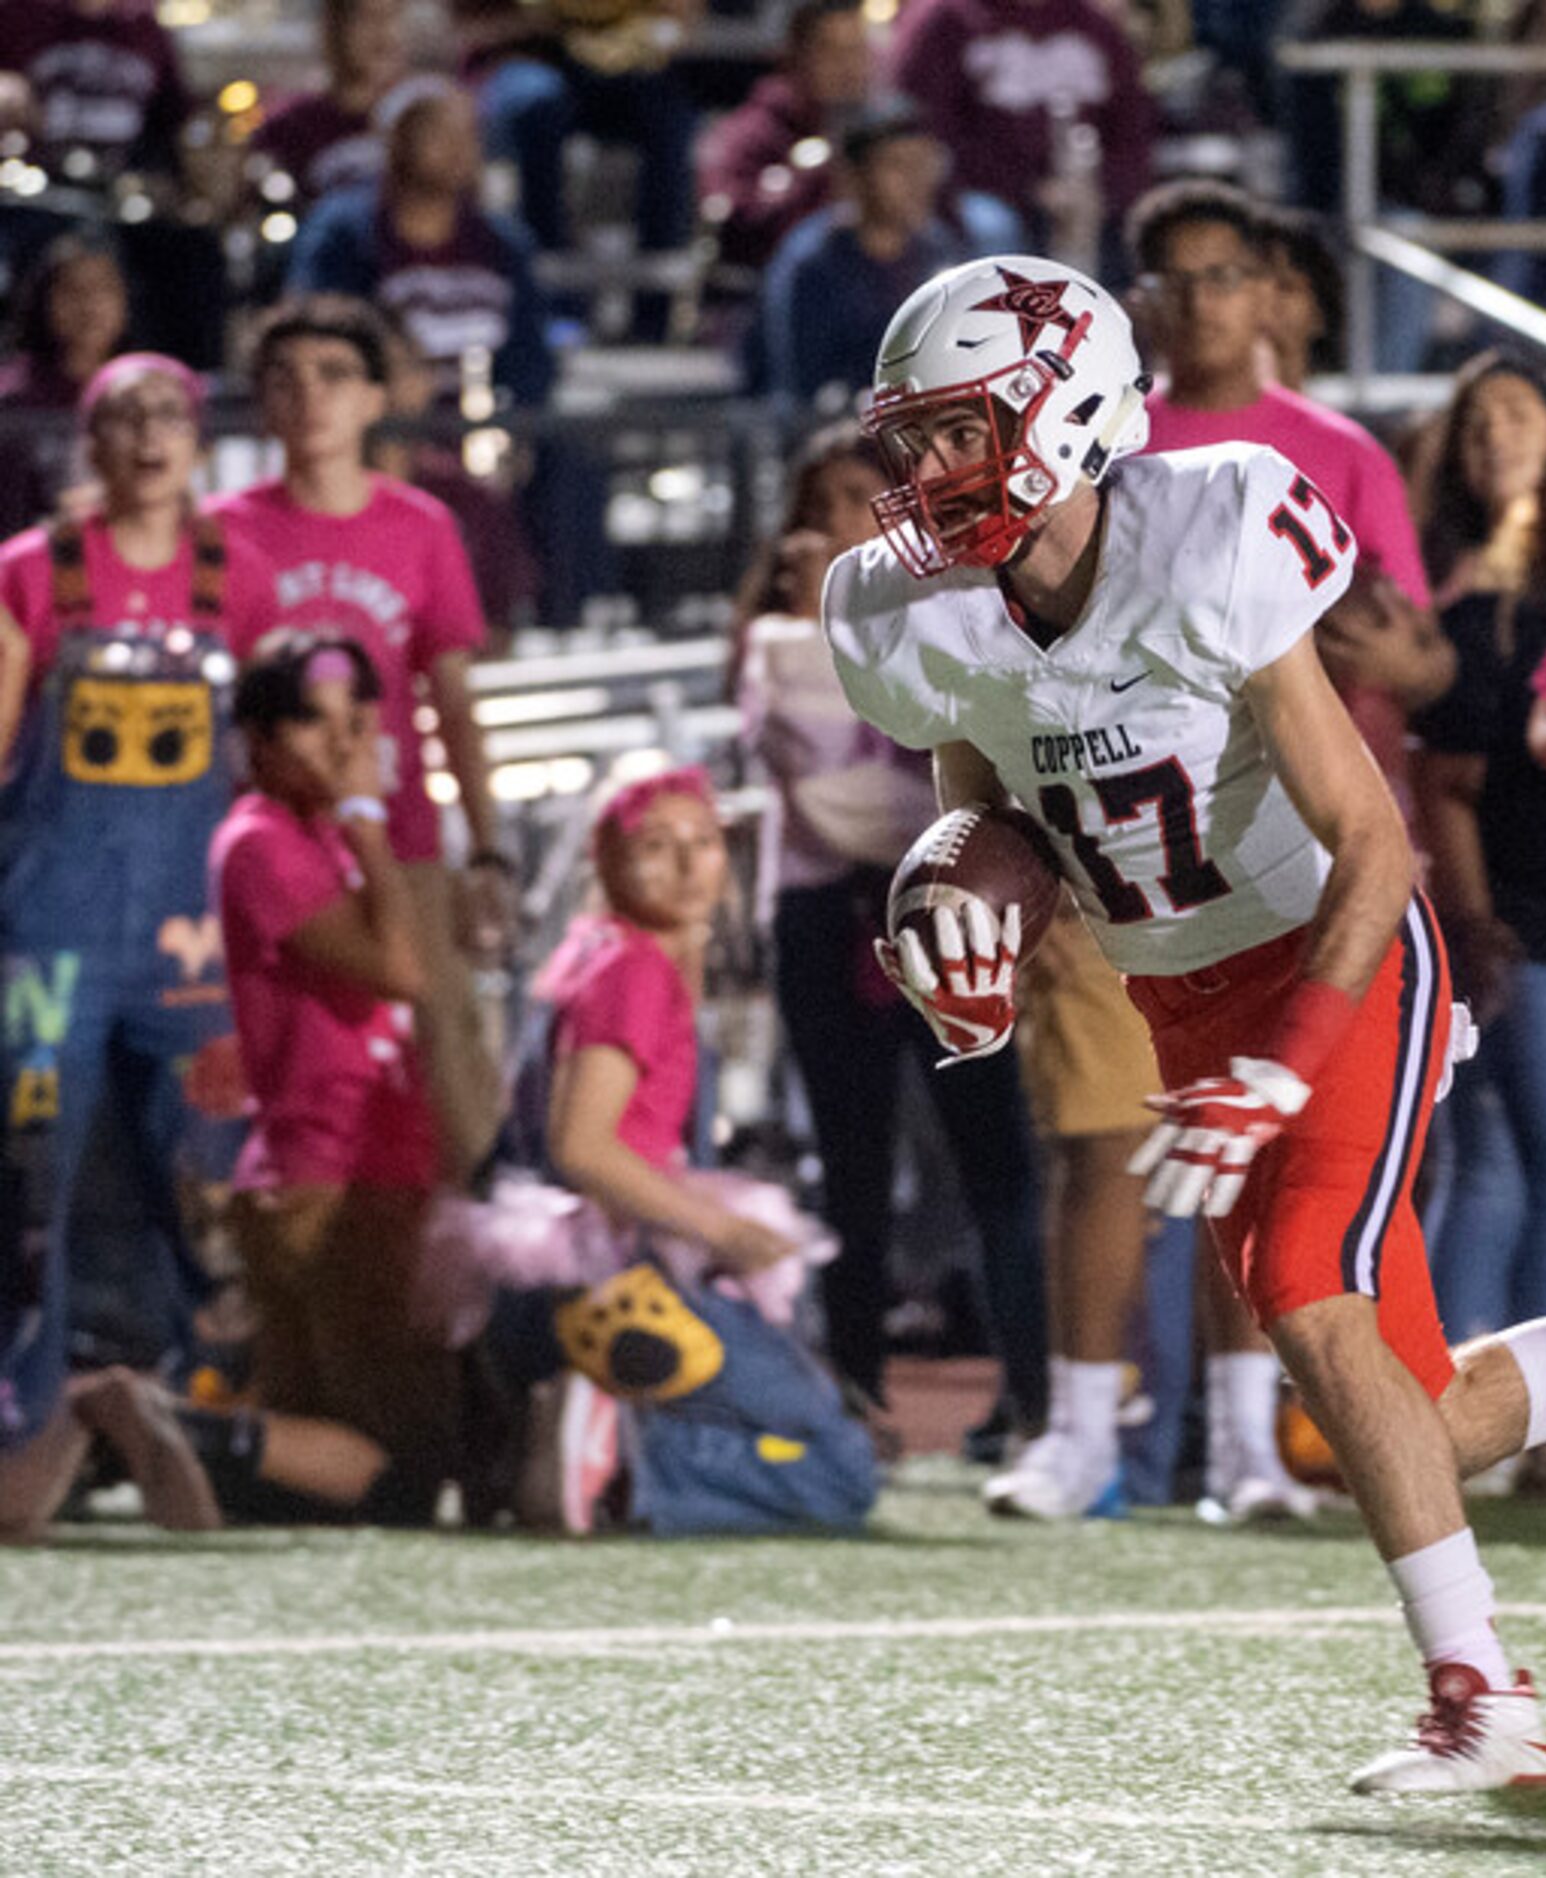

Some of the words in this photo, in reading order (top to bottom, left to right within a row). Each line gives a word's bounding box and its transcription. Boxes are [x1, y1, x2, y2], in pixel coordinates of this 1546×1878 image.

[1268, 473, 1352, 591] 17
[1031, 723, 1142, 775] COPPELL
[1037, 754, 1233, 925] 17
